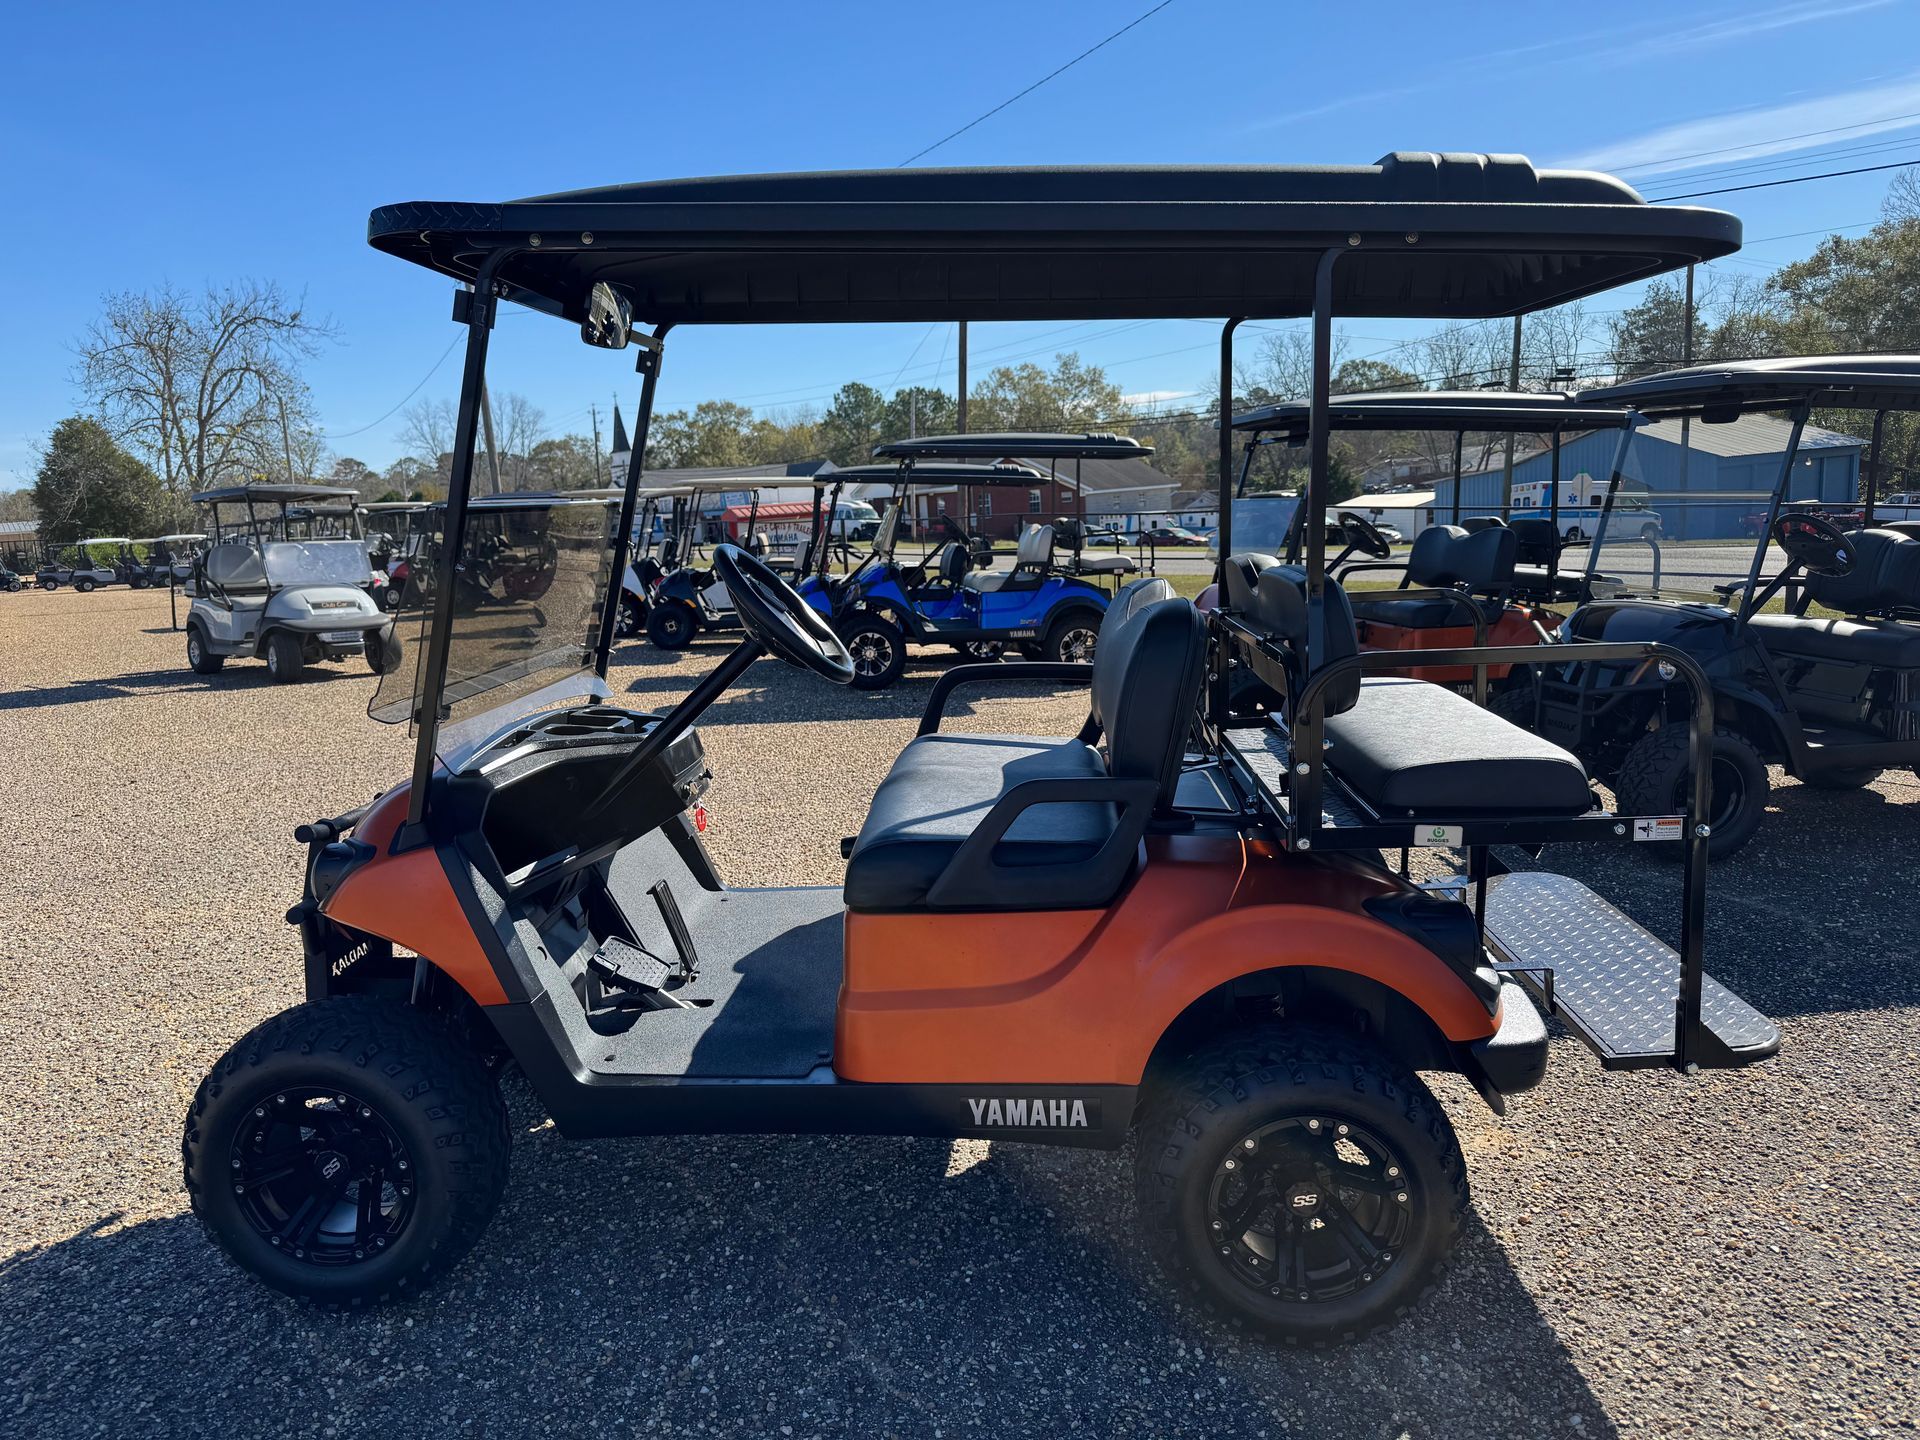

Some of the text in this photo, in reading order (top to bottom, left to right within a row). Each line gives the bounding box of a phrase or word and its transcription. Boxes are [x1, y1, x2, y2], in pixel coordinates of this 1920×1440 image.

[769, 533, 799, 543] YAMAHA
[1009, 629, 1036, 638] YAMAHA
[968, 1099, 1088, 1127] YAMAHA
[322, 1157, 341, 1179] SS
[1292, 1194, 1317, 1207] SS
